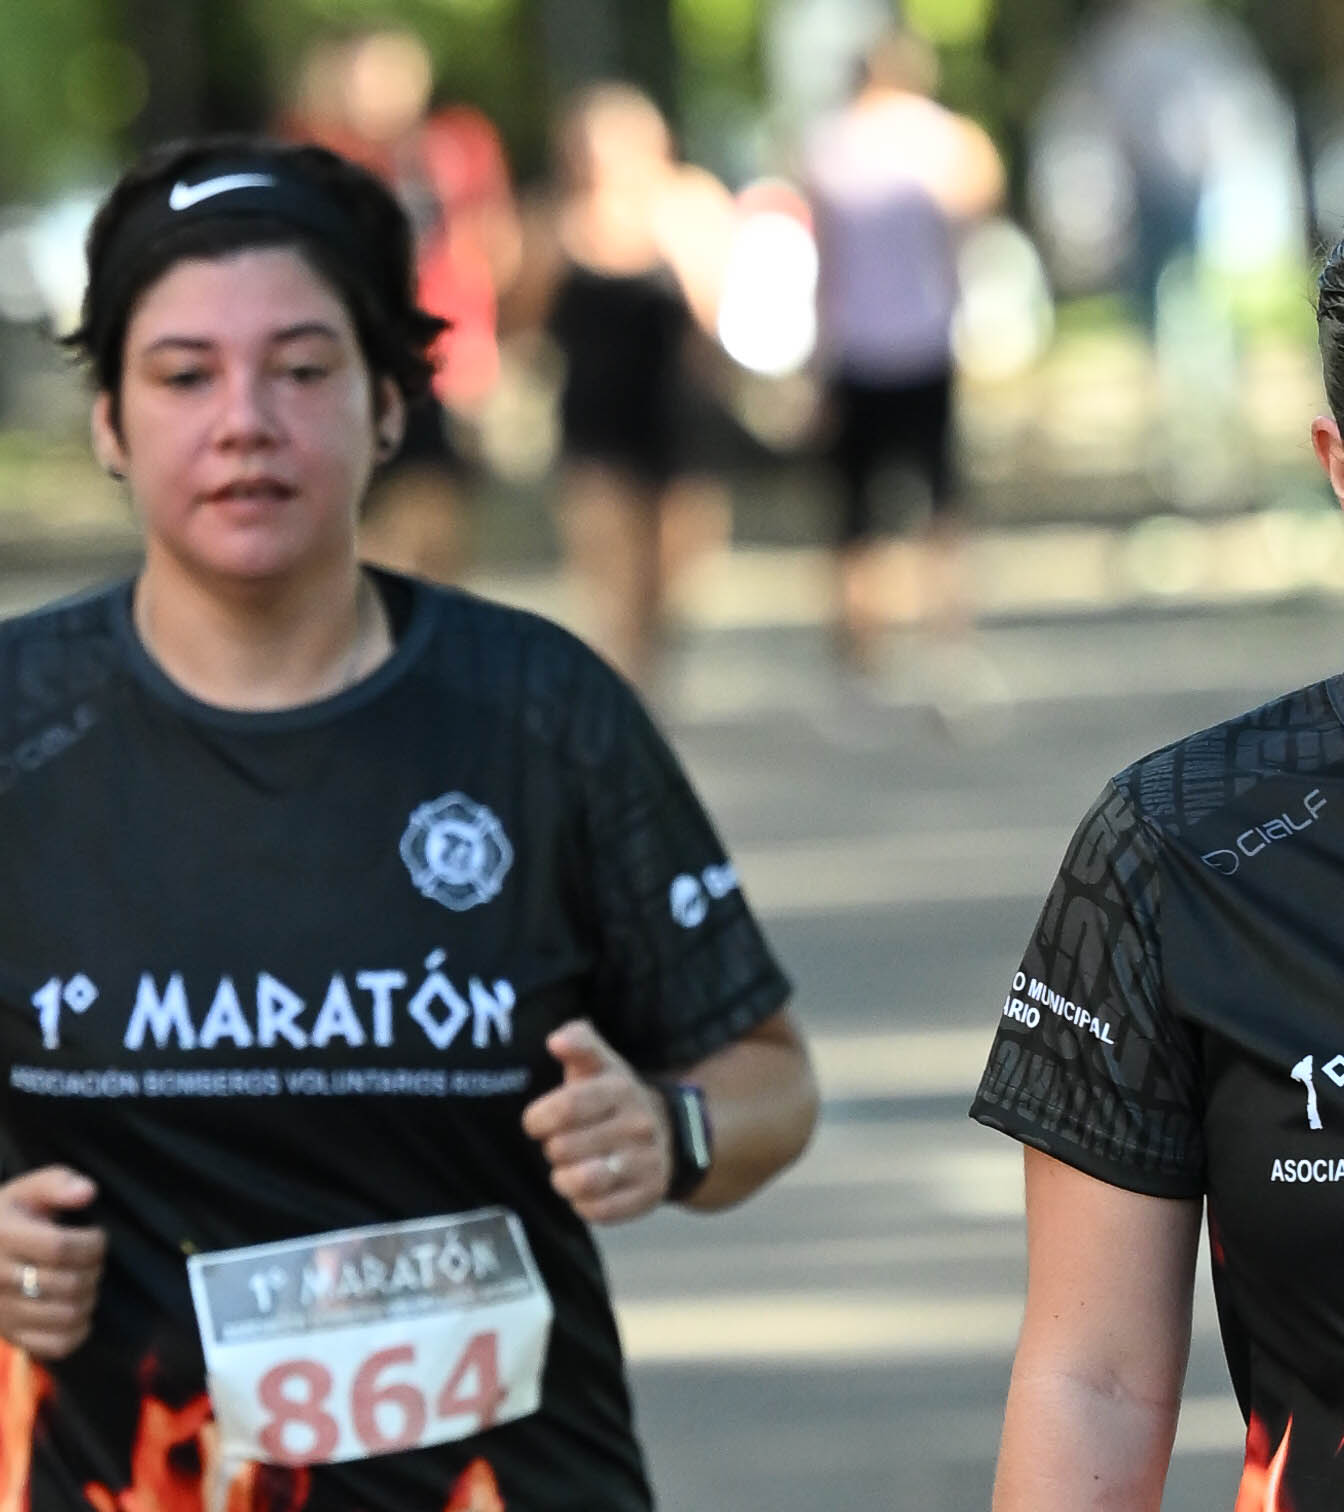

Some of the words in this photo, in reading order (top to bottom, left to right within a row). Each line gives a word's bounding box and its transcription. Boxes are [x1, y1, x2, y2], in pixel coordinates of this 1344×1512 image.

[124, 947, 516, 1050] MARATÓN
[1027, 978, 1115, 1045] MUNICIPAL
[256, 1328, 506, 1466] 864
